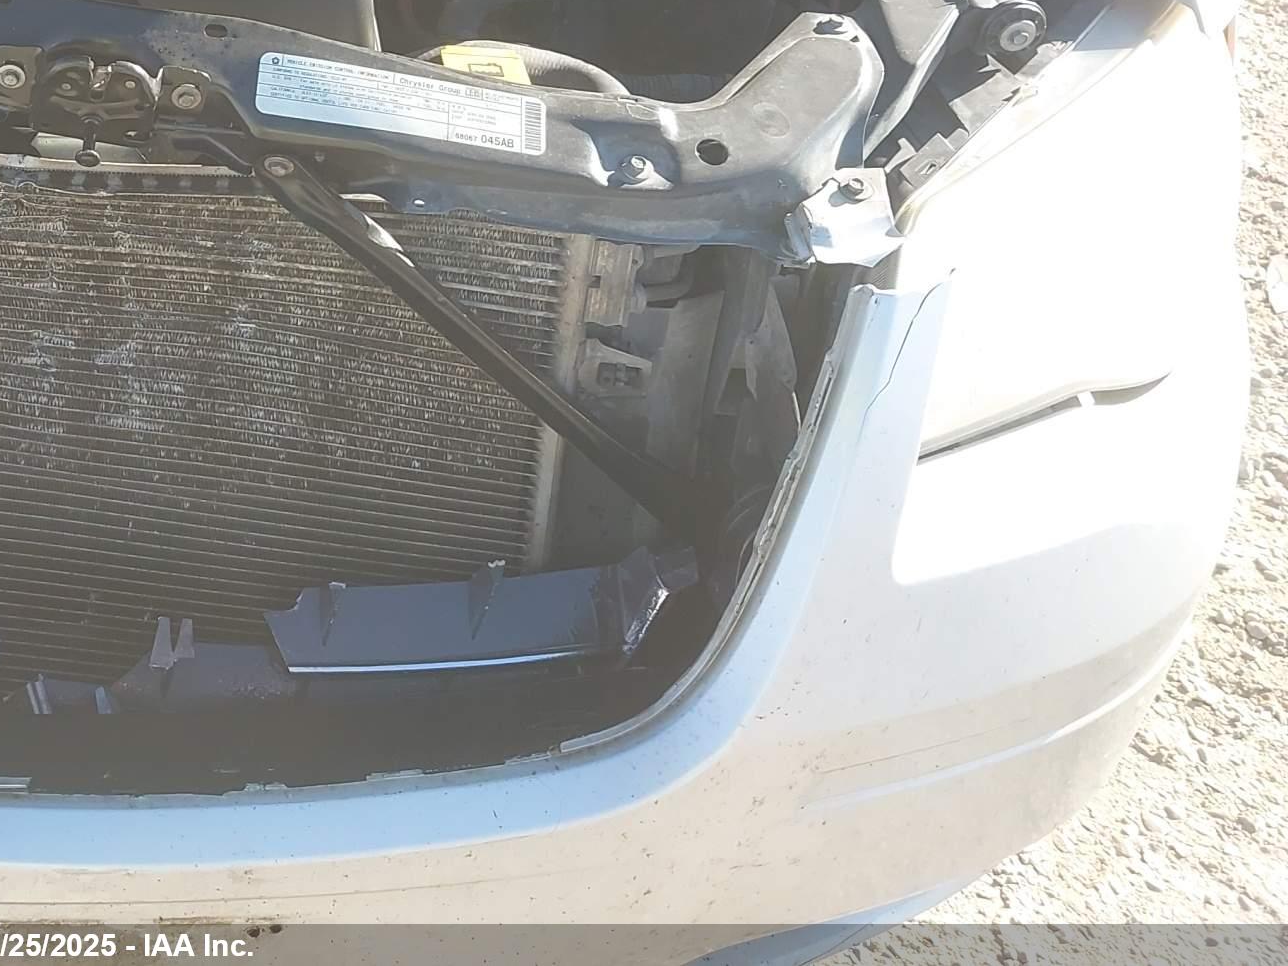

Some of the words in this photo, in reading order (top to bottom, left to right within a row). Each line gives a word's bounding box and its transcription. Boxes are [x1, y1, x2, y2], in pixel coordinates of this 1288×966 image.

[399, 77, 434, 90] Chrysler
[438, 84, 461, 96] Group
[481, 134, 515, 148] 045AB
